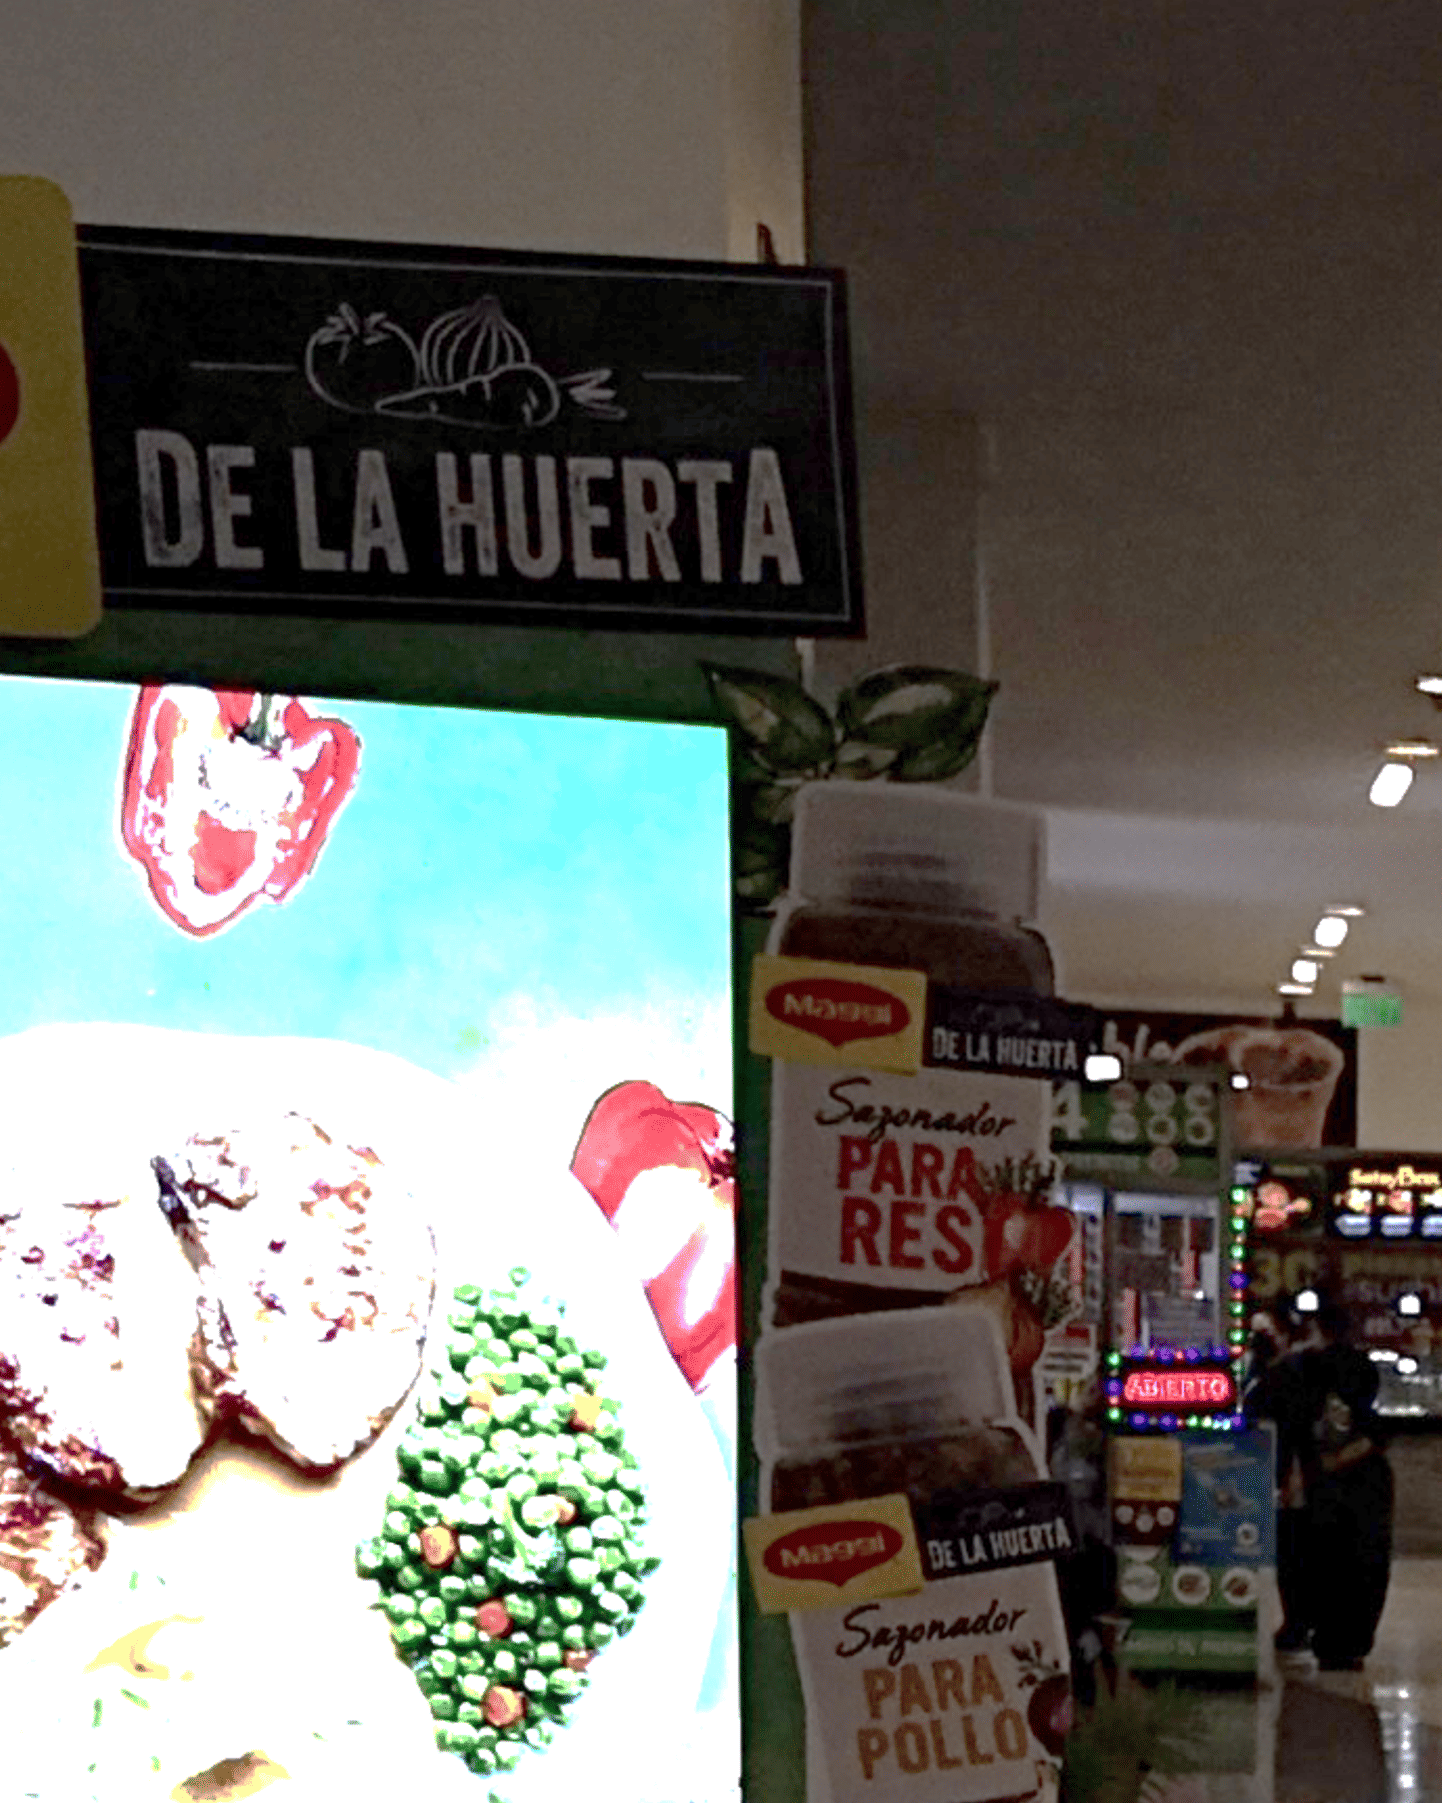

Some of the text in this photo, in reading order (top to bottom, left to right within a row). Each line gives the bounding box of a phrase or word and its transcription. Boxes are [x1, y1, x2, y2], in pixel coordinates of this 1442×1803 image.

[135, 429, 804, 586] DE LA HUERTA
[932, 1027, 959, 1060] DE
[965, 1032, 992, 1064] LA
[997, 1035, 1079, 1071] HUERTA
[816, 1078, 1017, 1142] Sazonador
[838, 1135, 981, 1198] PARA
[839, 1196, 973, 1273] RES
[1125, 1372, 1229, 1402] ABIERTO
[927, 1517, 1072, 1570] DE LA HUERTA
[836, 1600, 1026, 1666] Sazonador
[863, 1654, 1005, 1720] PARA
[858, 1709, 1029, 1780] POLLO
